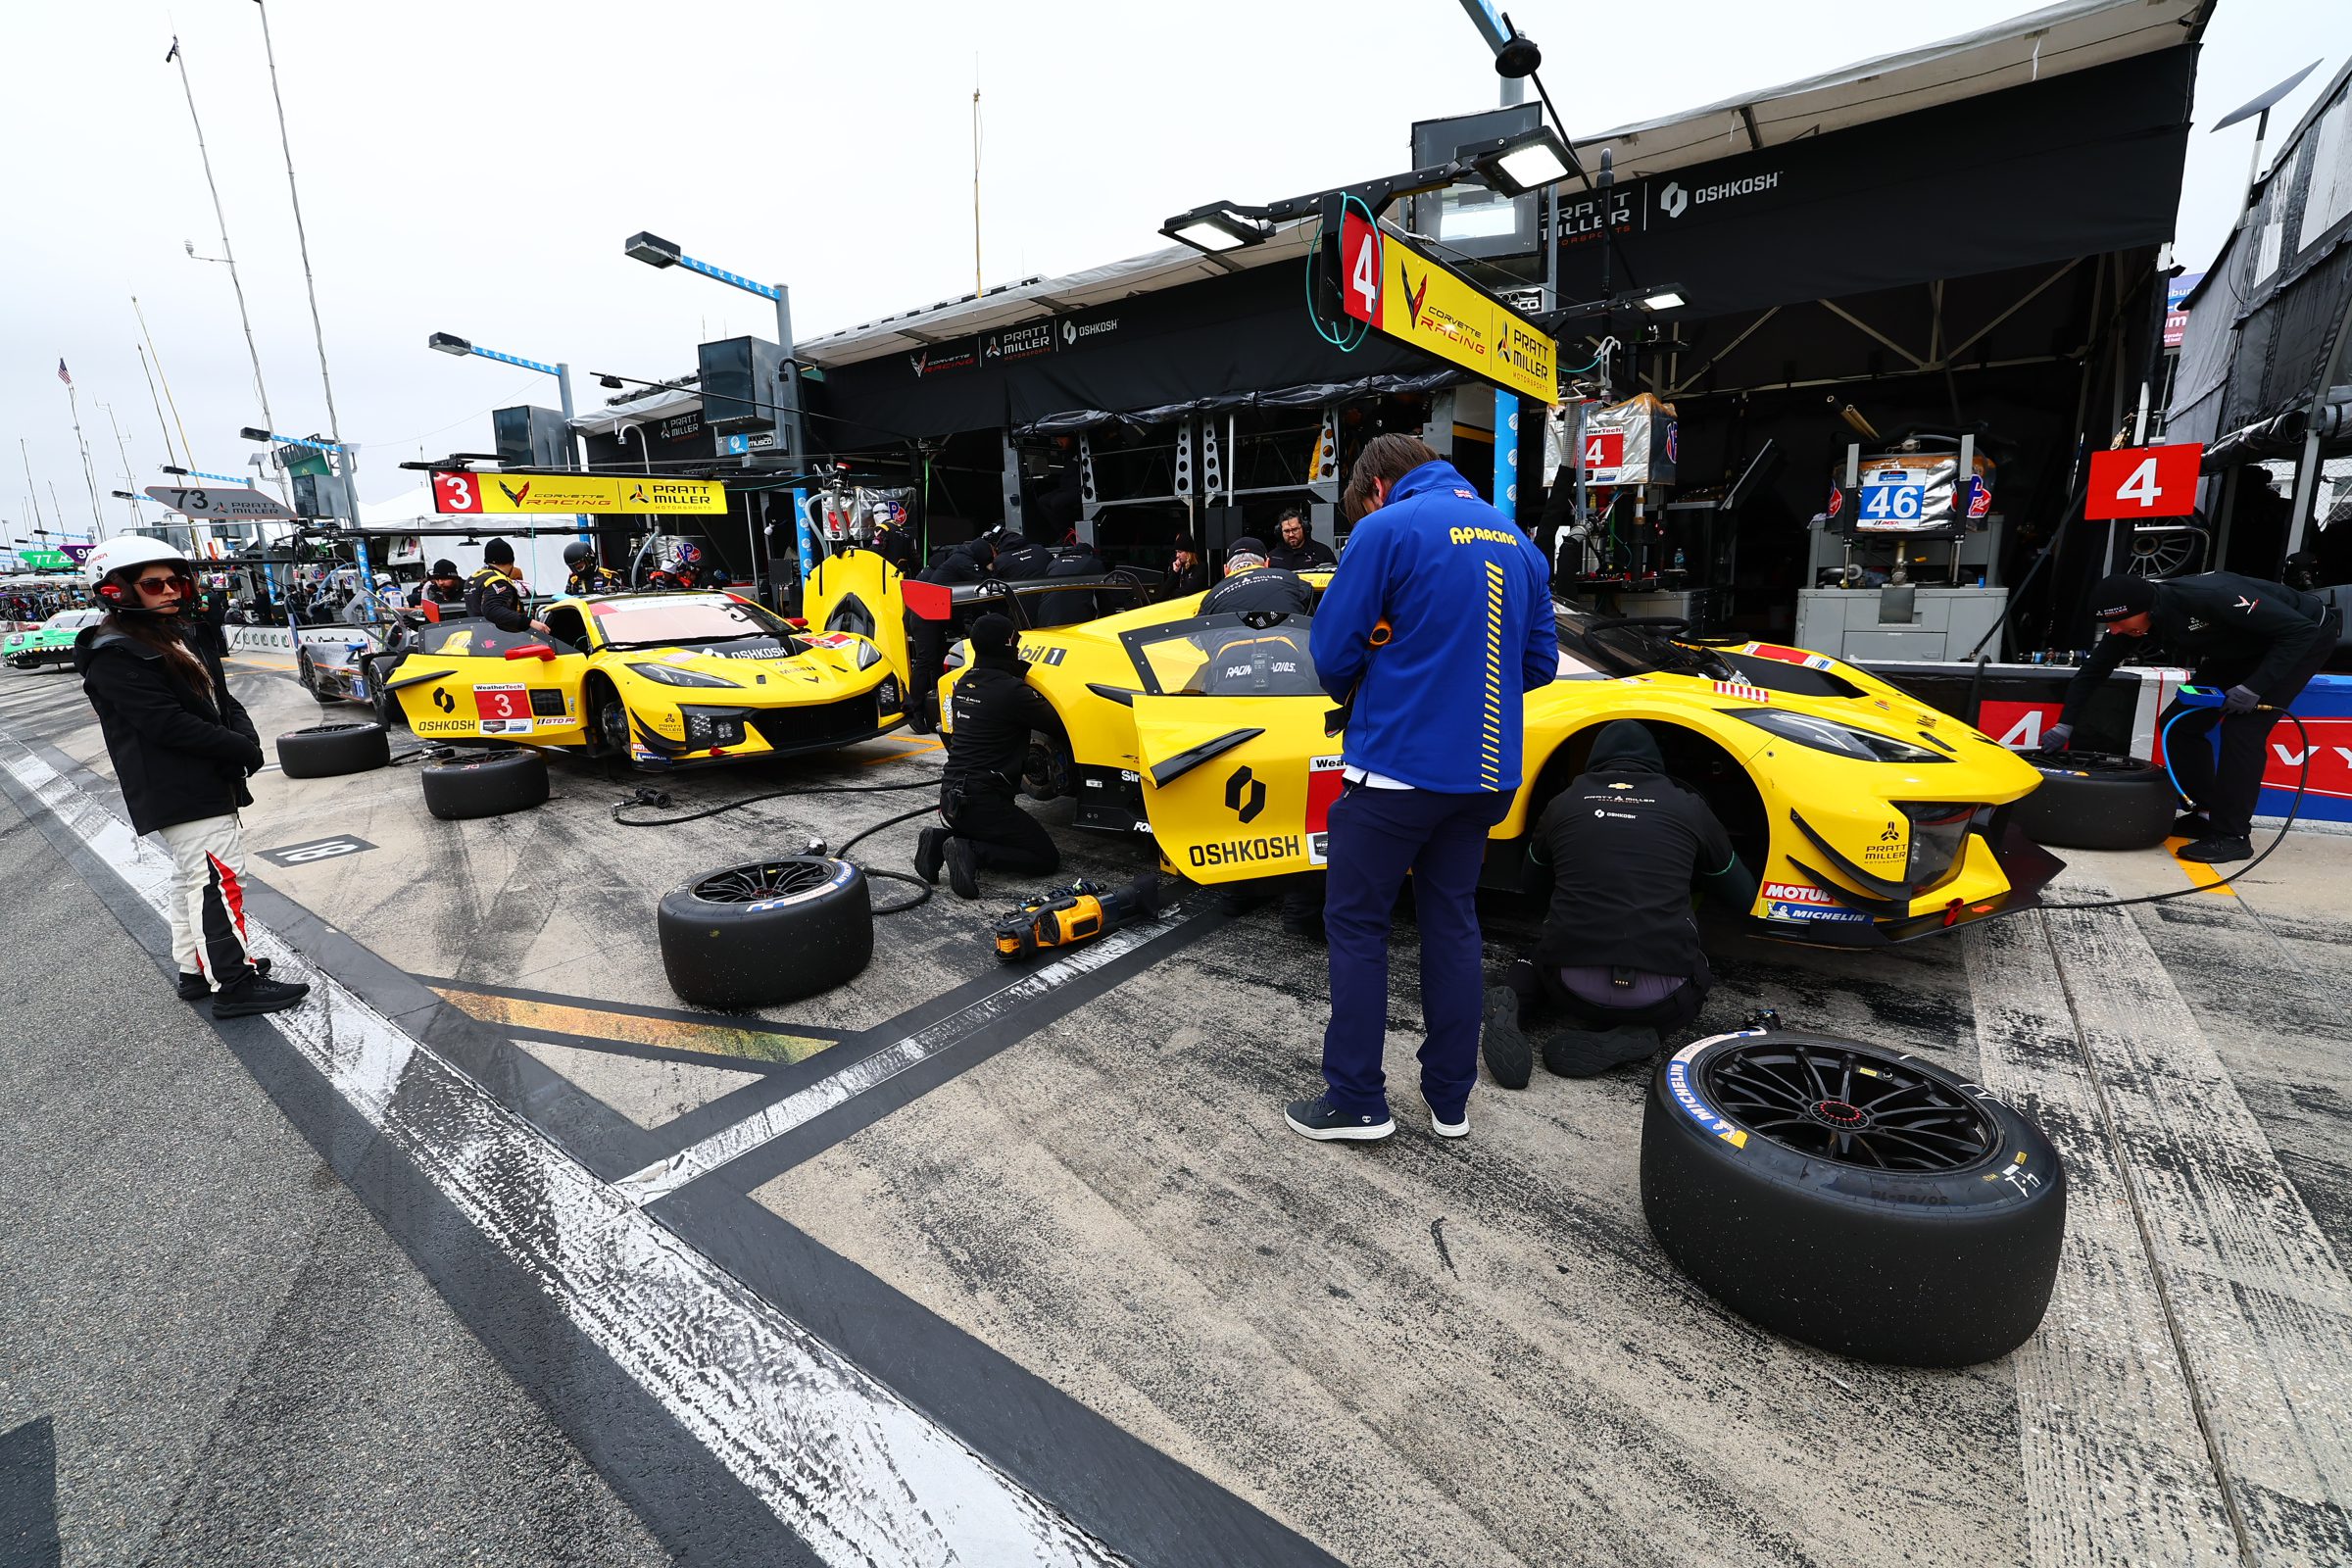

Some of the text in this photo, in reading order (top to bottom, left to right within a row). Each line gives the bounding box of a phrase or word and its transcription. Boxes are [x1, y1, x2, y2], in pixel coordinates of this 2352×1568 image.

[1695, 172, 1779, 204] OSHKOSH
[1352, 233, 1377, 314] 4
[1079, 319, 1118, 337] OSHKOSH
[1428, 306, 1482, 339] CORVETTE
[1003, 324, 1050, 344] PRATT
[1421, 316, 1486, 355] RACING
[1004, 336, 1050, 355] MILLER
[1513, 328, 1548, 362] PRATT
[923, 357, 975, 373] RACING
[927, 353, 971, 367] CORVETTE
[1513, 353, 1548, 381] MILLER
[1513, 371, 1548, 393] MOTORSPORTS
[670, 414, 698, 428] PRATT
[671, 422, 699, 437] MILLER
[1586, 438, 1604, 466] 4
[653, 484, 709, 495] PRATT
[2116, 457, 2163, 507] 4
[171, 489, 209, 510] 73
[446, 476, 472, 510] 3
[654, 495, 710, 505] MILLER
[1866, 486, 1919, 518] 46
[1449, 526, 1518, 547] AP RACING
[32, 554, 52, 564] 77
[731, 647, 788, 660] OSHKOSH
[1018, 644, 1061, 664] bil 1
[1225, 664, 1252, 679] RACIN
[494, 693, 514, 717] 3
[418, 719, 476, 732] OSHKOSH
[1998, 710, 2043, 751] 4
[1189, 834, 1300, 867] OSHKOSH
[1864, 852, 1907, 860] MILLER
[1866, 843, 1907, 853] PRATT
[1765, 884, 1831, 903] MOTUL
[1791, 909, 1867, 922] MICHELIN
[1669, 1063, 1716, 1121] MICHELIN
